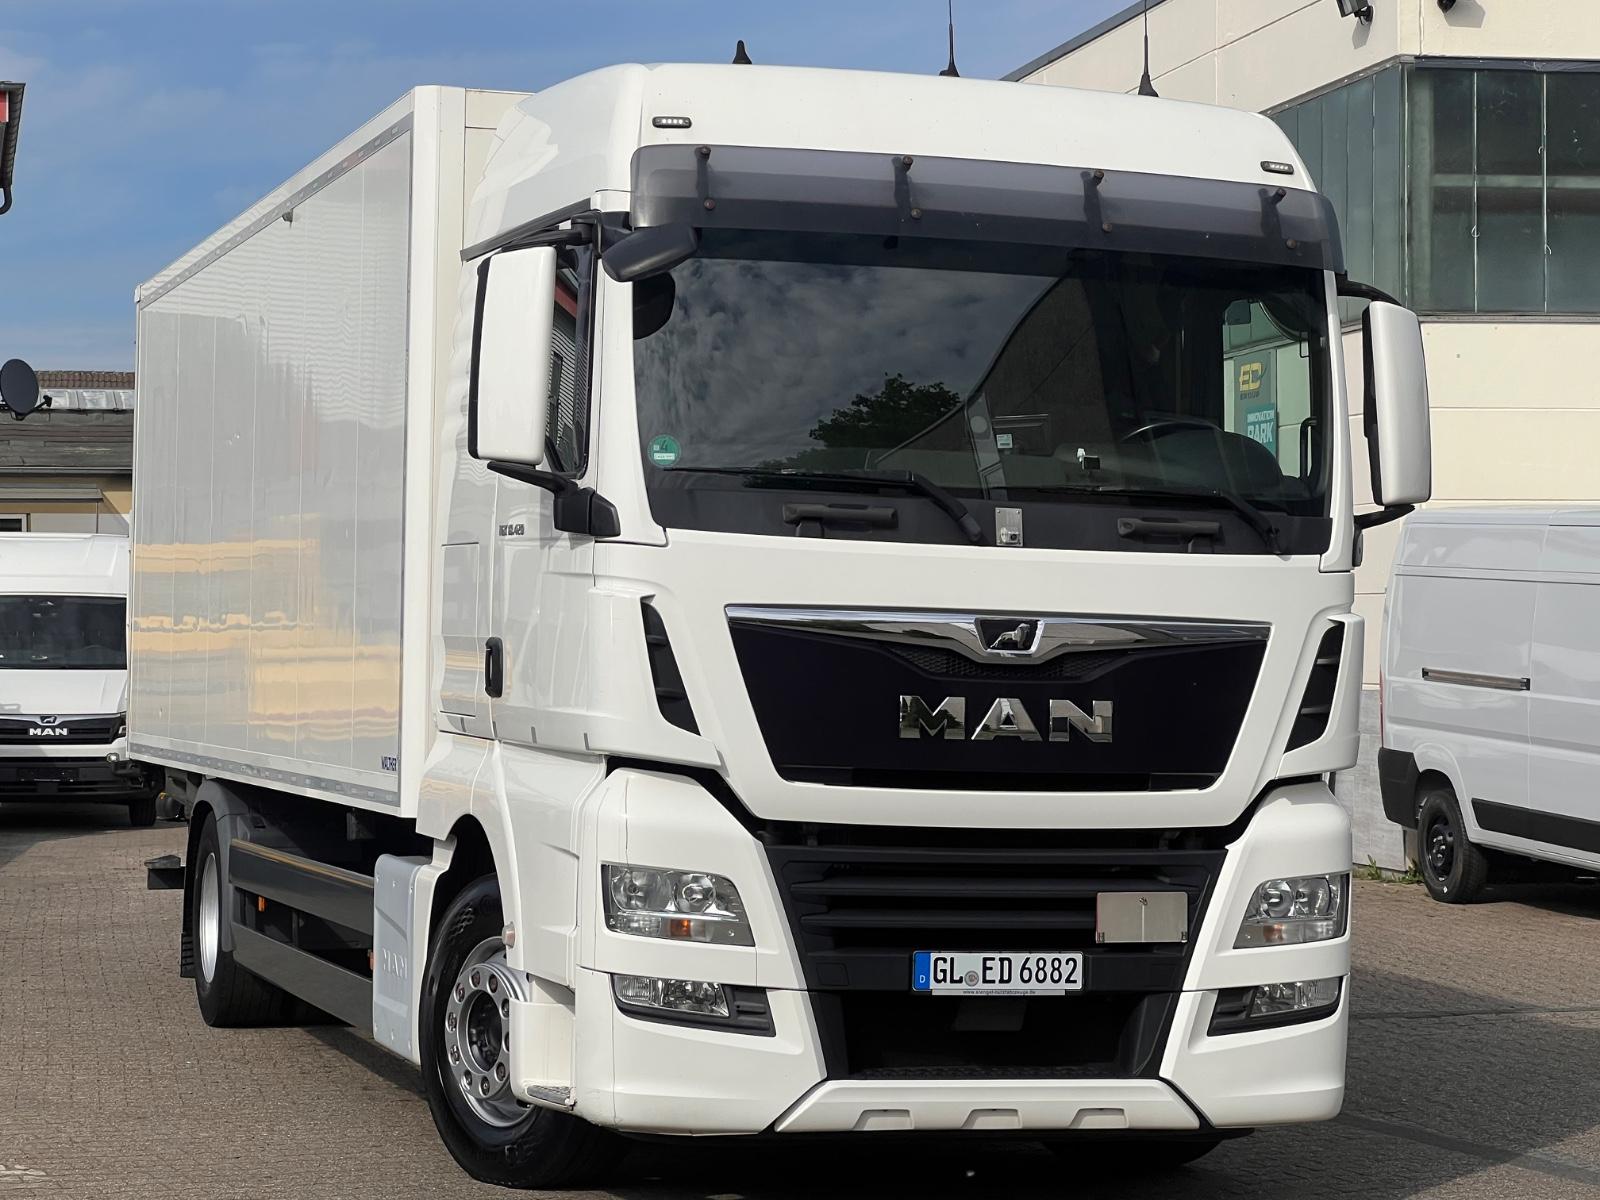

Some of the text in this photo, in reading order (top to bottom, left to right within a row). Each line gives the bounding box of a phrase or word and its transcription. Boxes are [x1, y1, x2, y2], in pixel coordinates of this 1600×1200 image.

[1247, 421, 1274, 443] PARK
[900, 695, 1113, 743] MAN
[29, 728, 68, 736] MAN
[919, 957, 1078, 984] D GL ED 6882
